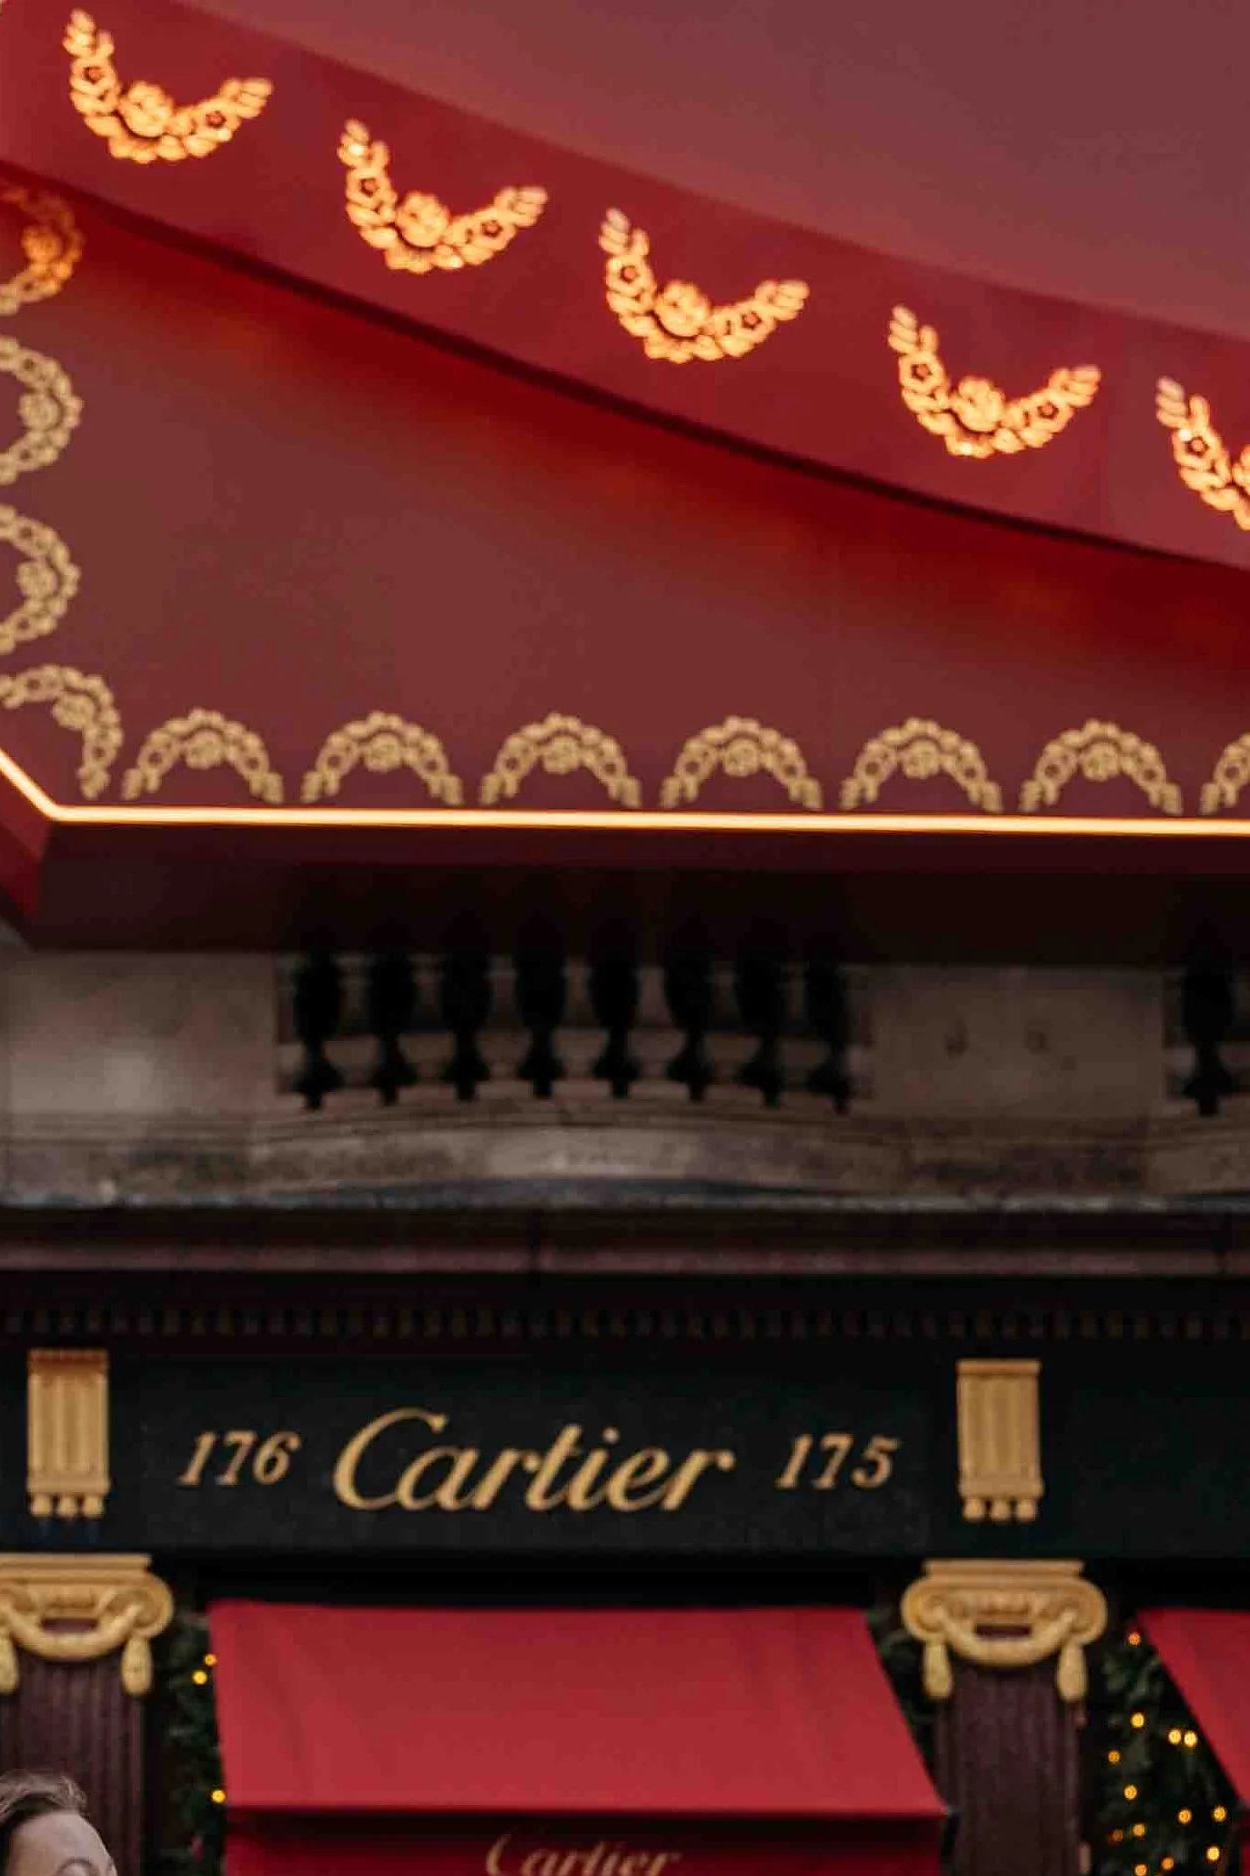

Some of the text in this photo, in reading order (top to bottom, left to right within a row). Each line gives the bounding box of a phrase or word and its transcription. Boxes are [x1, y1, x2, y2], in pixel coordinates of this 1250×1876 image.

[177, 1406, 901, 1511] 176 Cartier 175
